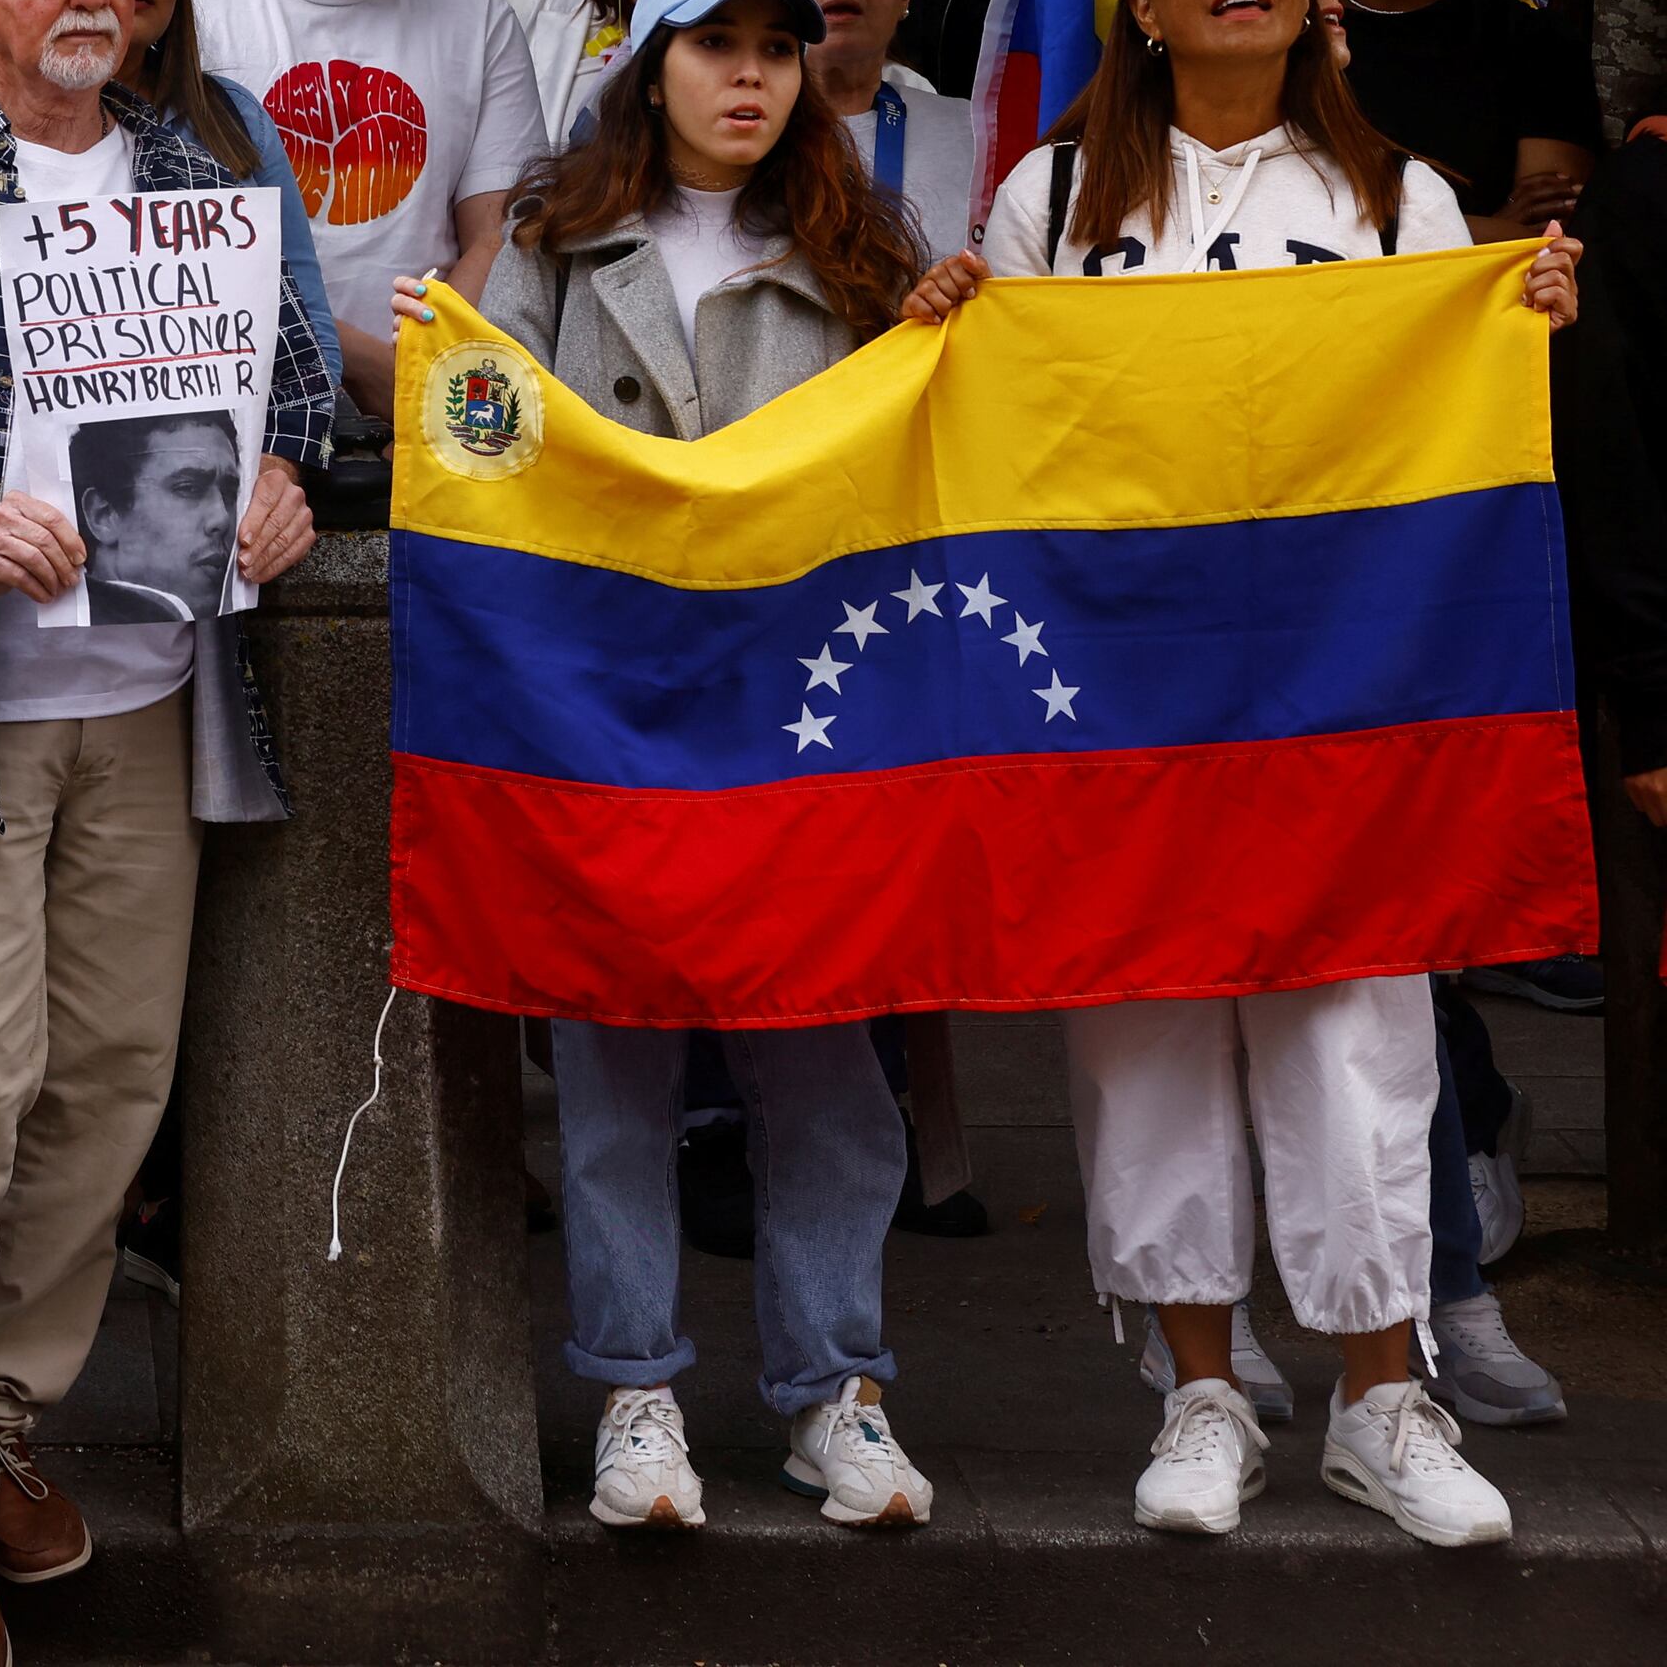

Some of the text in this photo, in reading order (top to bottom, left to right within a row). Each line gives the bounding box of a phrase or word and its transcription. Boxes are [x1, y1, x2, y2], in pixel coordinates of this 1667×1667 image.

[23, 194, 256, 261] +5 YEARS
[236, 359, 258, 397] R.
